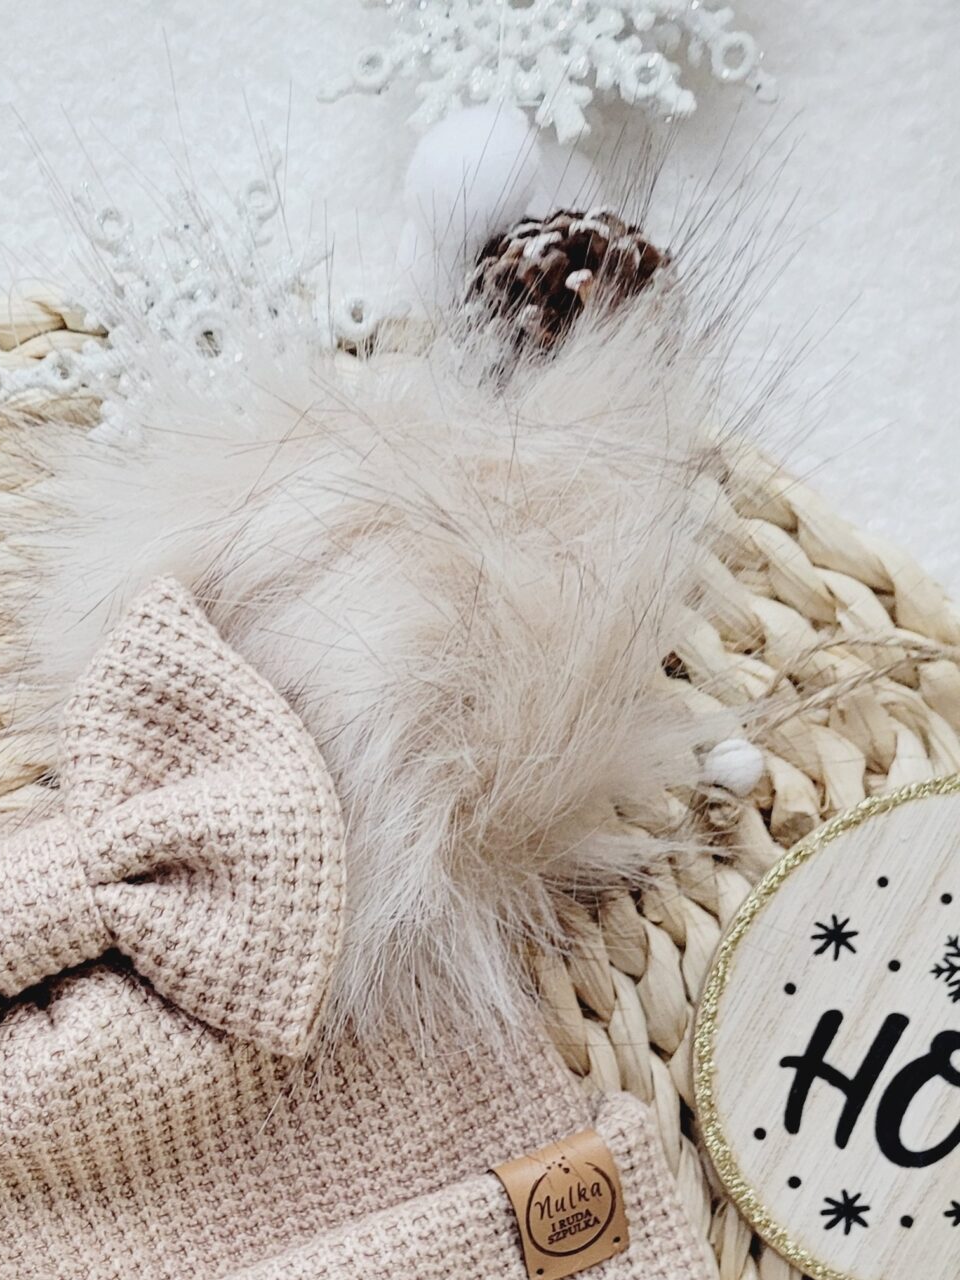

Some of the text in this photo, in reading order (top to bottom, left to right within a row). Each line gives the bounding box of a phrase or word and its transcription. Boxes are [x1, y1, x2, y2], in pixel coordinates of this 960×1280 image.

[534, 1181, 603, 1220] Nulka
[547, 1216, 601, 1245] SZPULKA
[551, 1208, 593, 1233] I RUDA
